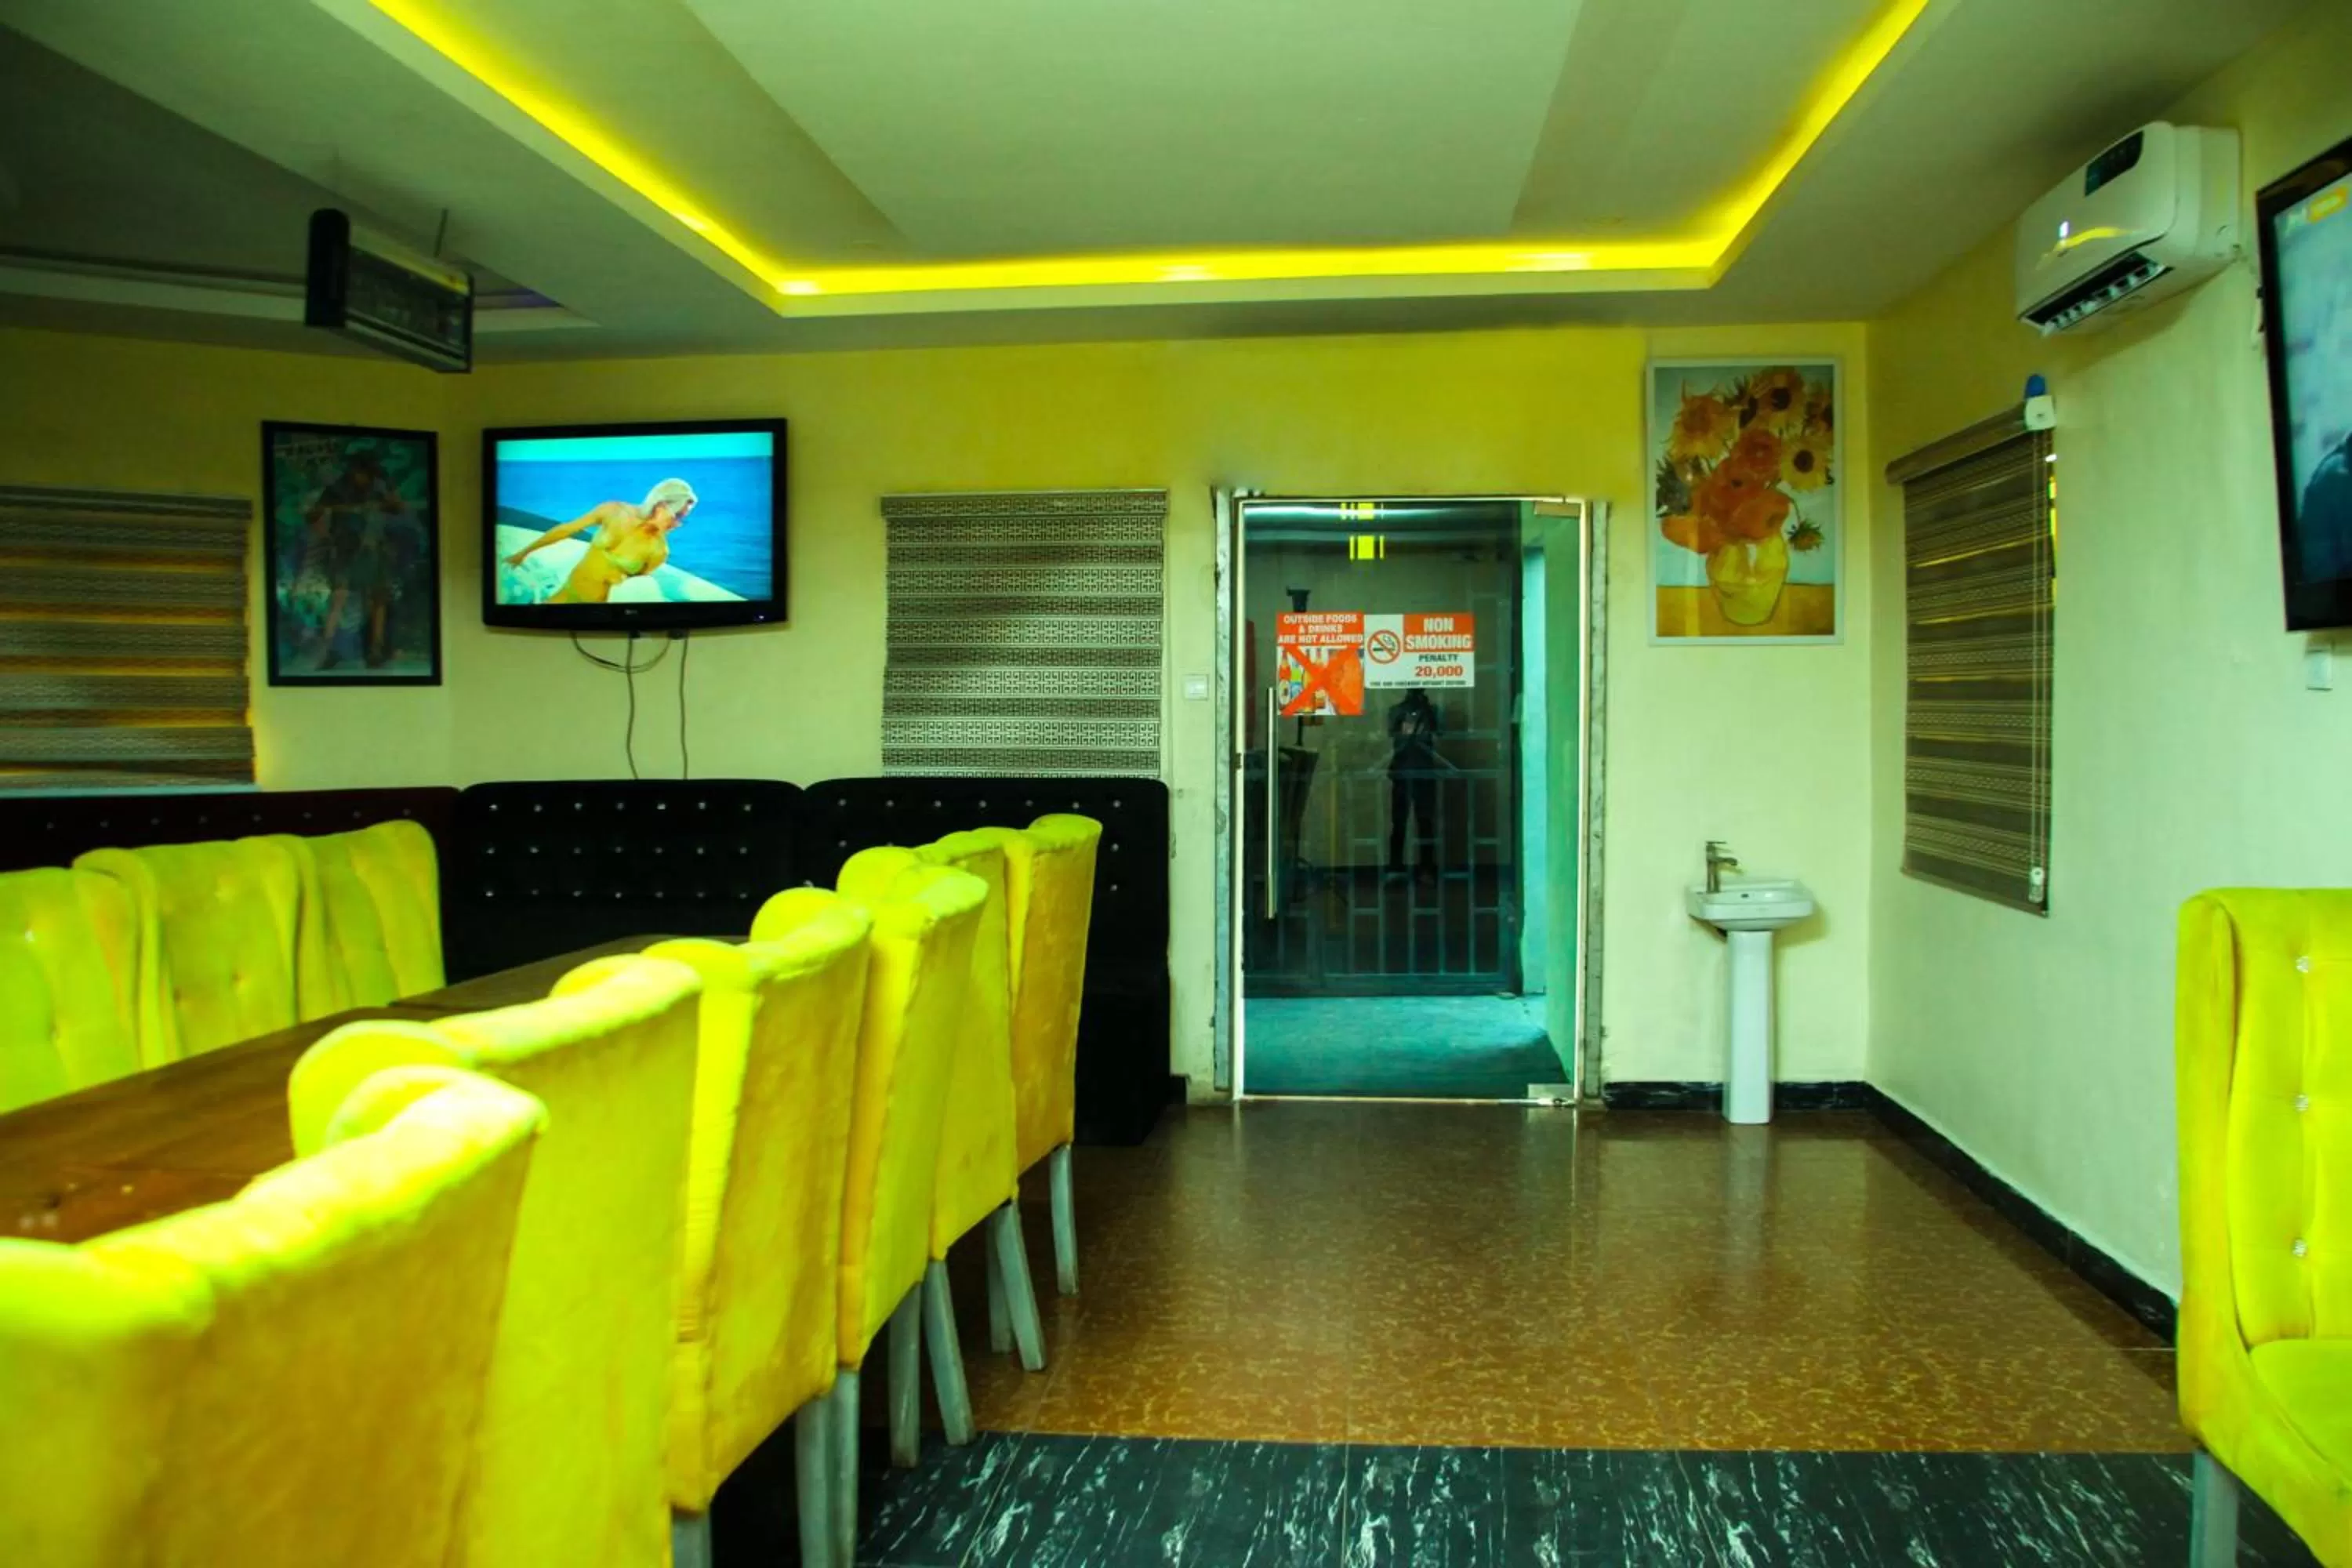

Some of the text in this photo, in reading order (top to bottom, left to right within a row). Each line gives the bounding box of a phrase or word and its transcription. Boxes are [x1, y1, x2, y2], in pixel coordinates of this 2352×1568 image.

[1283, 614, 1356, 624] OUTSIDE FOODS
[1423, 617, 1454, 632] NON
[1308, 624, 1342, 633] DRINKS
[1278, 633, 1363, 644] ARE NOT ALLOWED
[1406, 635, 1472, 649] SMOKING
[1418, 654, 1459, 662] PENALTY
[1415, 665, 1464, 678] 20,000
